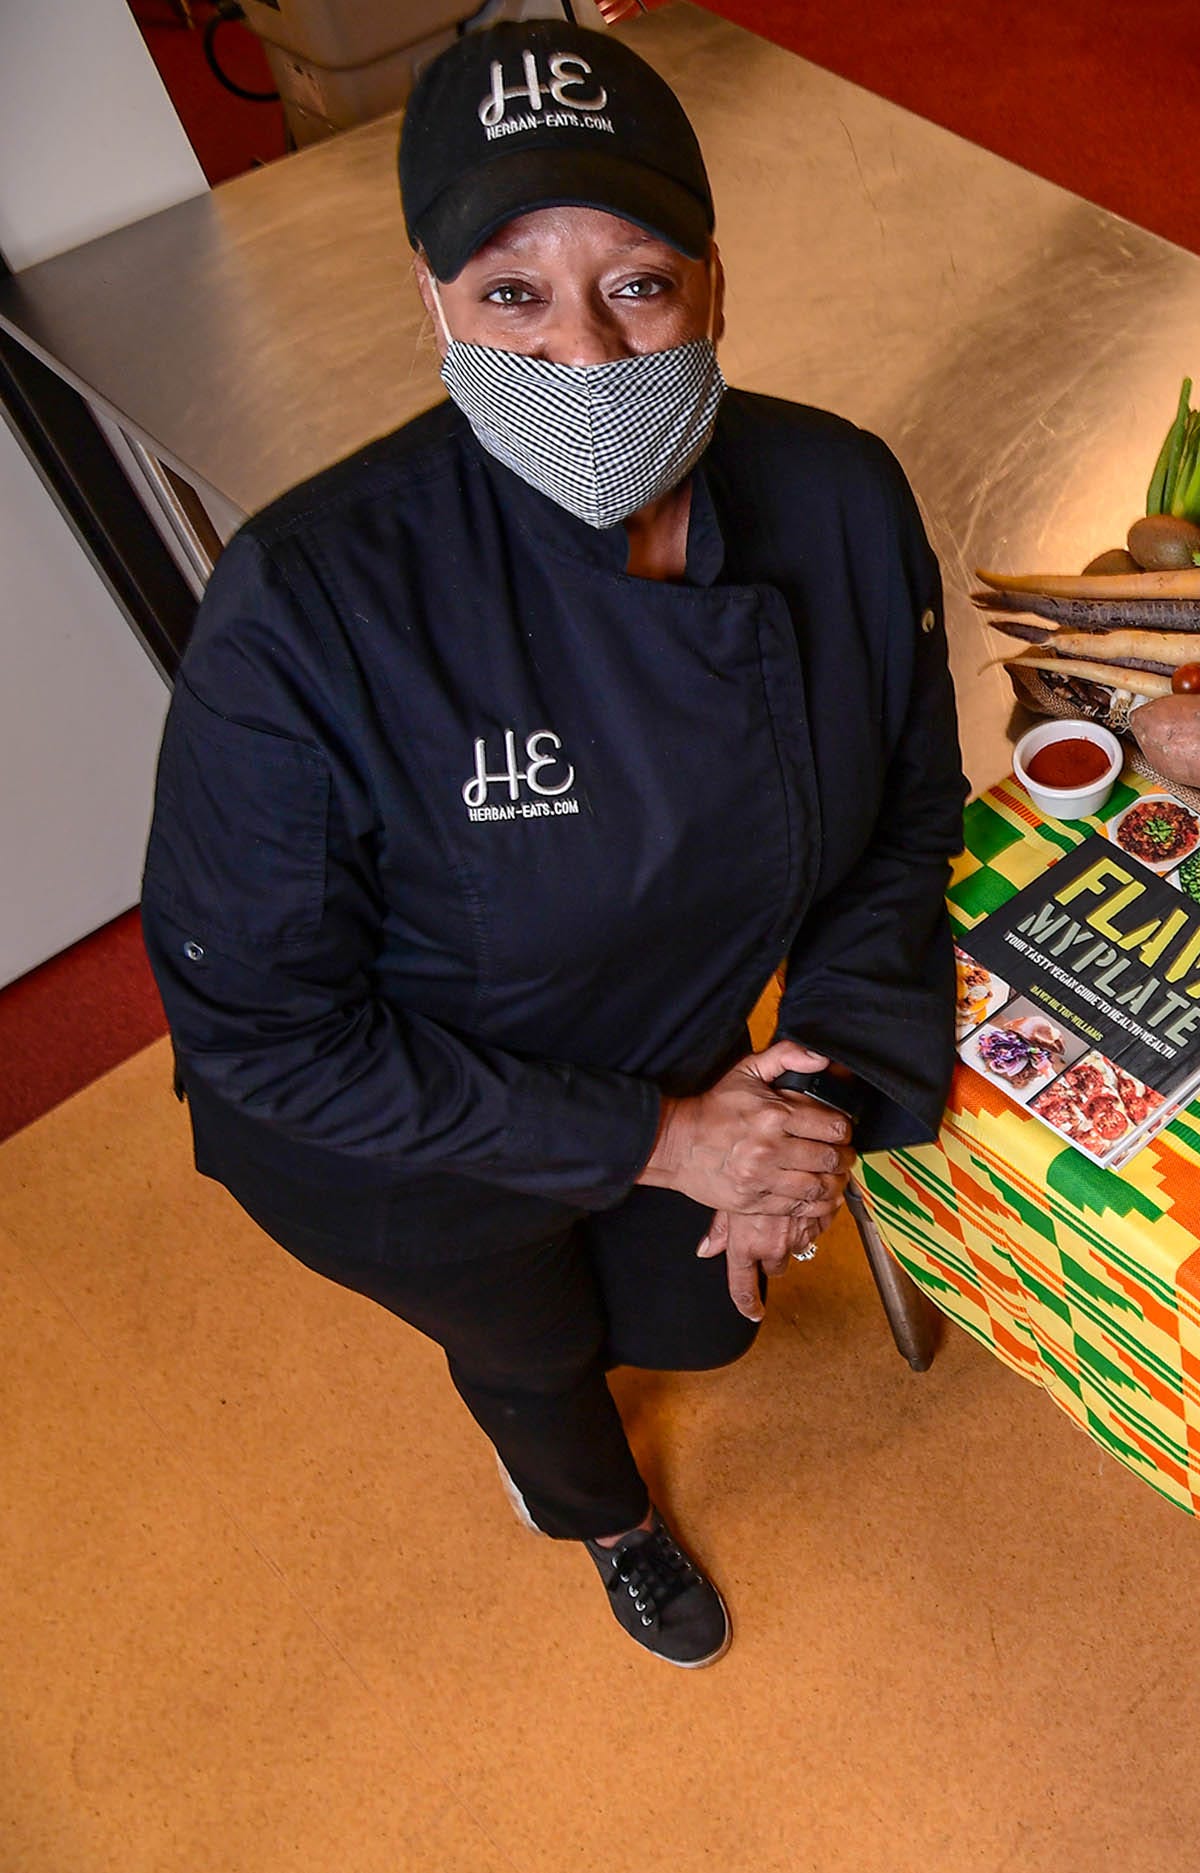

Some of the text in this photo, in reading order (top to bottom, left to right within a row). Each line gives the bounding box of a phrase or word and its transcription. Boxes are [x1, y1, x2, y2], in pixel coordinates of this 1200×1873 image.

[478, 50, 607, 126] HE
[486, 112, 615, 141] HERBAN-EATS.COM
[462, 729, 575, 807] HE
[468, 799, 579, 822] HERBAN-EATS.COM
[1004, 931, 1028, 952] YOUR
[1024, 945, 1054, 970] TASTY
[1050, 965, 1079, 989] VEGAN
[1074, 984, 1101, 1006] GUIDE
[1097, 1000, 1112, 1014] TO
